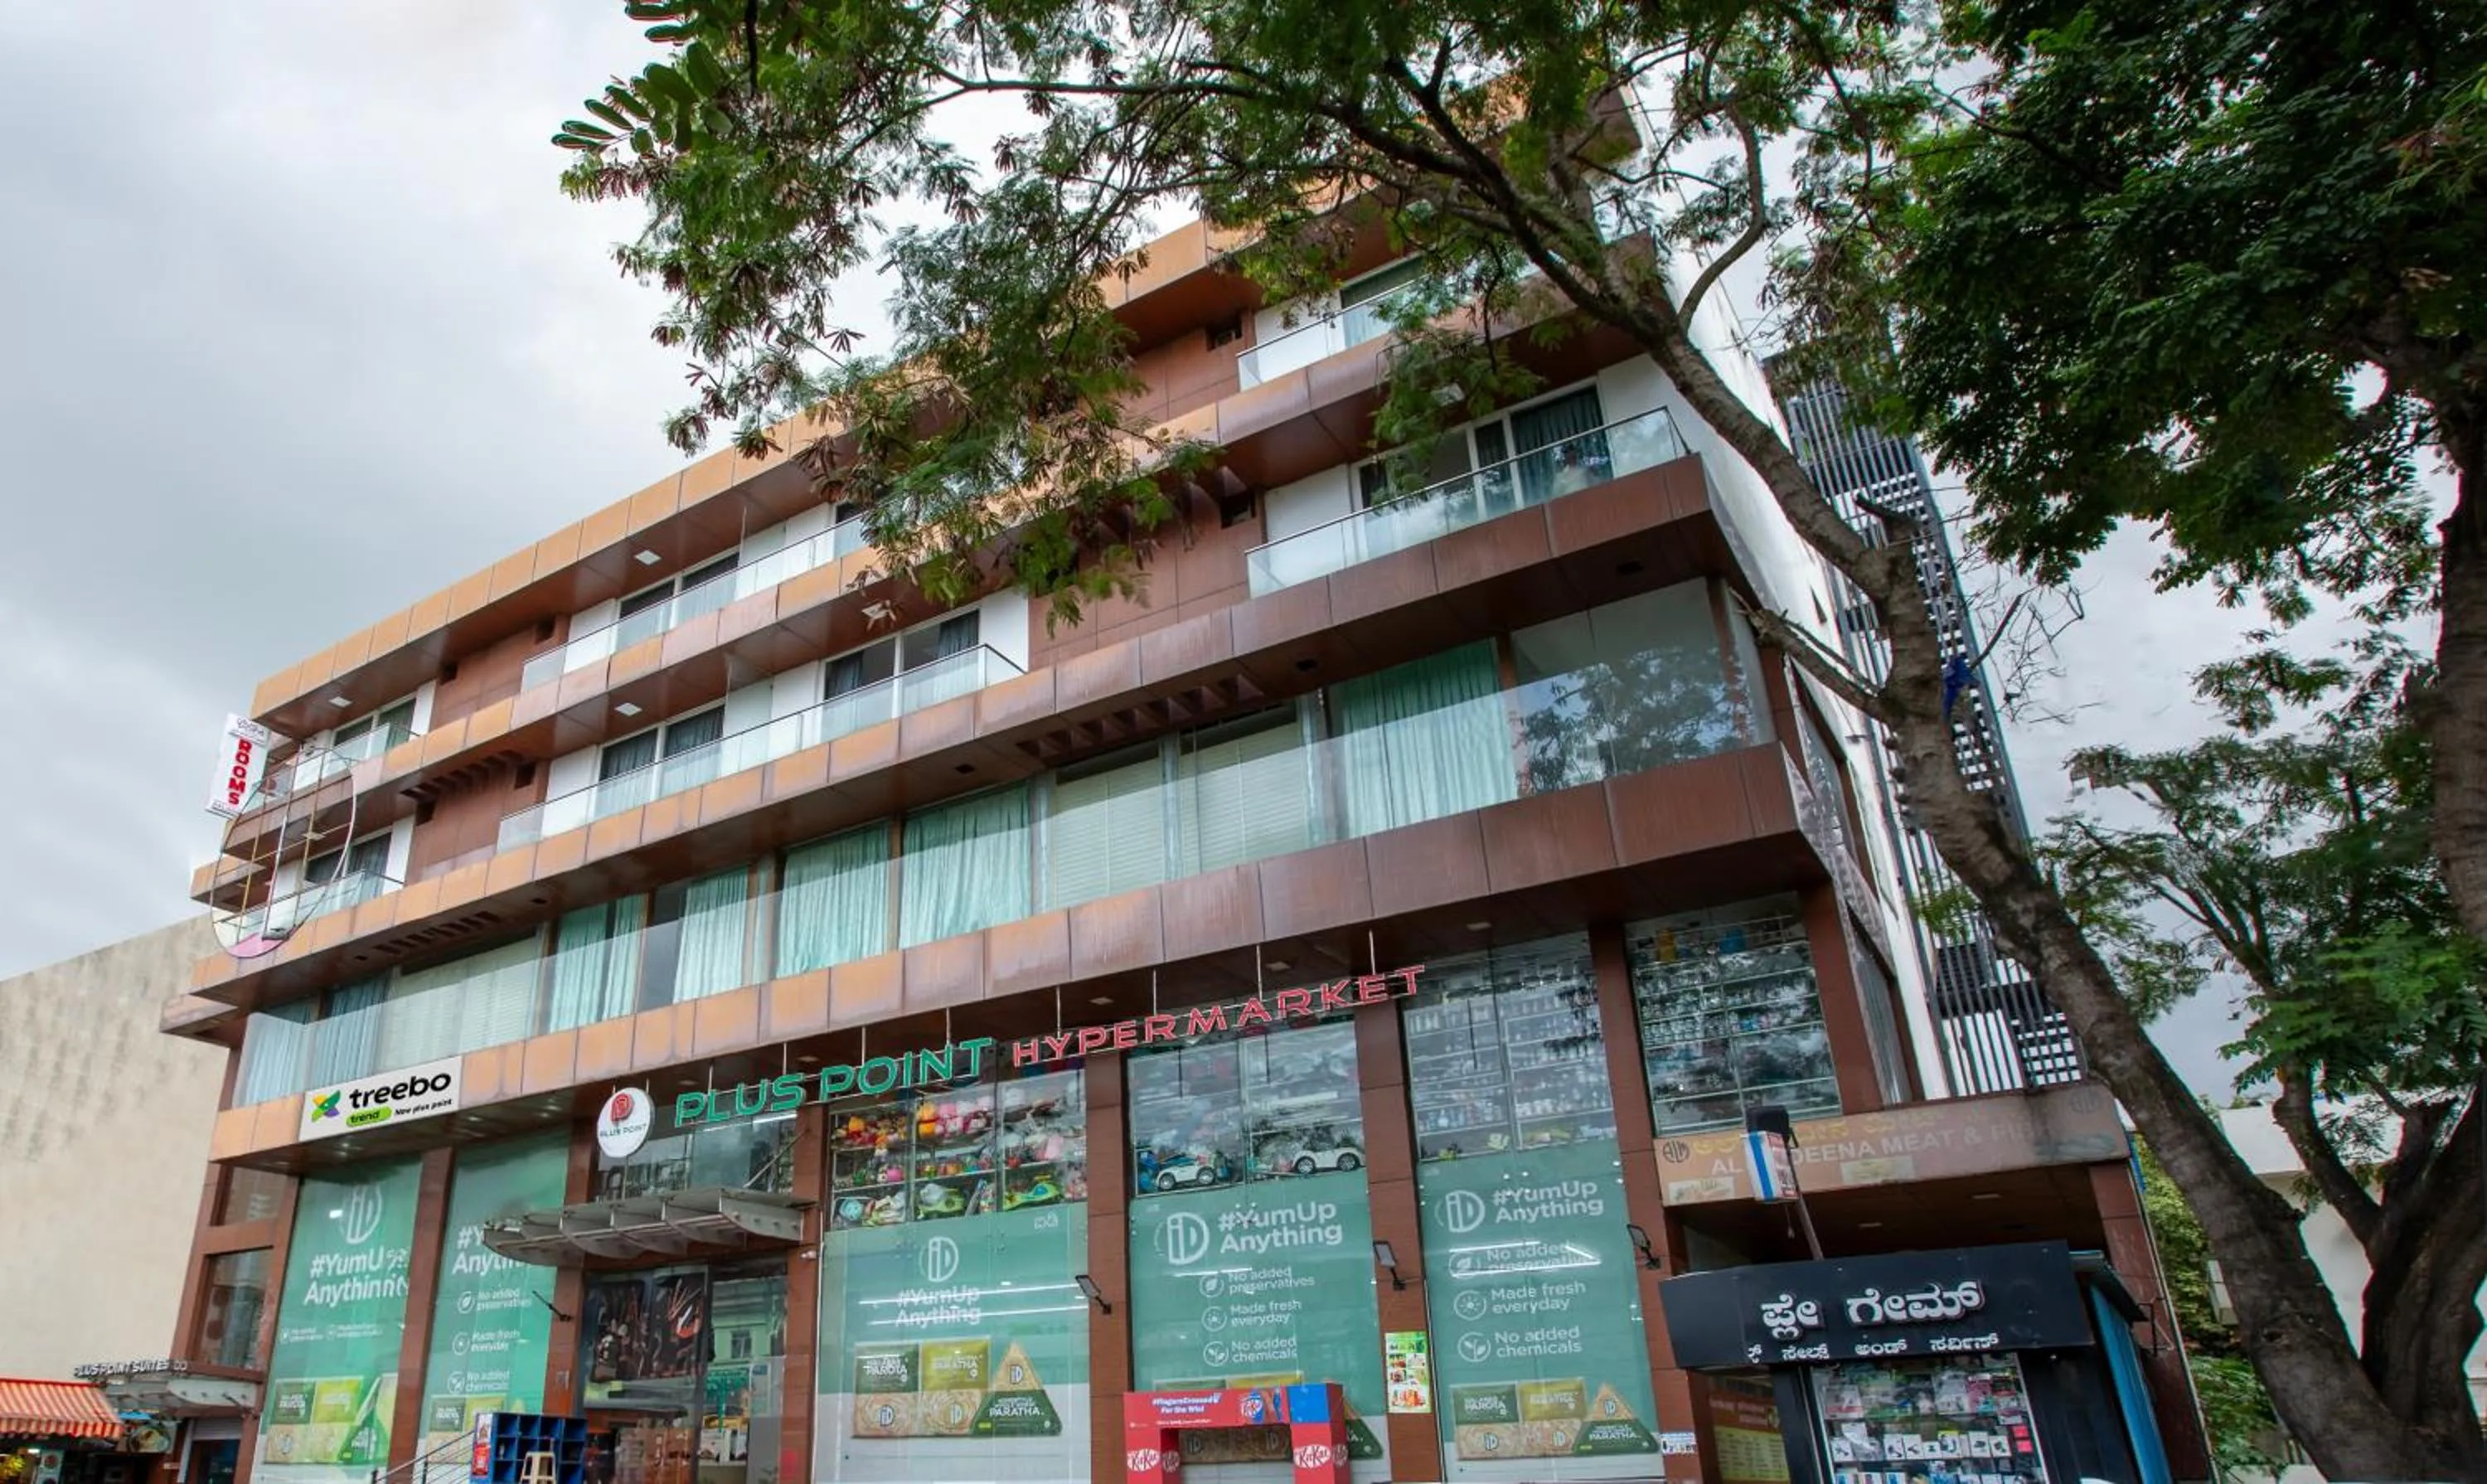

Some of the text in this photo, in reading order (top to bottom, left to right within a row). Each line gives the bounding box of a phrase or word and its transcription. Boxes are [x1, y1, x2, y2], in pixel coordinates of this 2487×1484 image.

[228, 738, 252, 804] ROOMS
[675, 964, 1425, 1128] PLUS POINT HYPERMARKET
[349, 1073, 451, 1108] treebo
[351, 1111, 381, 1123] trend
[623, 1123, 647, 1134] POINT
[1711, 1158, 1744, 1175] AL
[1790, 1139, 1876, 1164] DEENA
[1881, 1129, 1955, 1156] MEAT
[1964, 1126, 1983, 1145] &
[1493, 1181, 1597, 1205] #YumUp
[1218, 1201, 1336, 1232] #YumUp
[1495, 1199, 1604, 1224] Anything
[1219, 1224, 1343, 1254] Anything
[1487, 1249, 1511, 1261] No
[1251, 1266, 1292, 1281] added
[1229, 1275, 1316, 1296] preservatives
[1491, 1281, 1586, 1300] Made fresh
[1230, 1299, 1302, 1314] Made fresh
[1492, 1297, 1570, 1314] everyday
[1846, 1281, 1980, 1324] ಗೇಮ್
[1231, 1312, 1290, 1326] everyday
[1231, 1336, 1297, 1351] No added
[1495, 1326, 1579, 1344] No added
[1232, 1348, 1298, 1362] chemicals
[1496, 1339, 1583, 1358] chemicals
